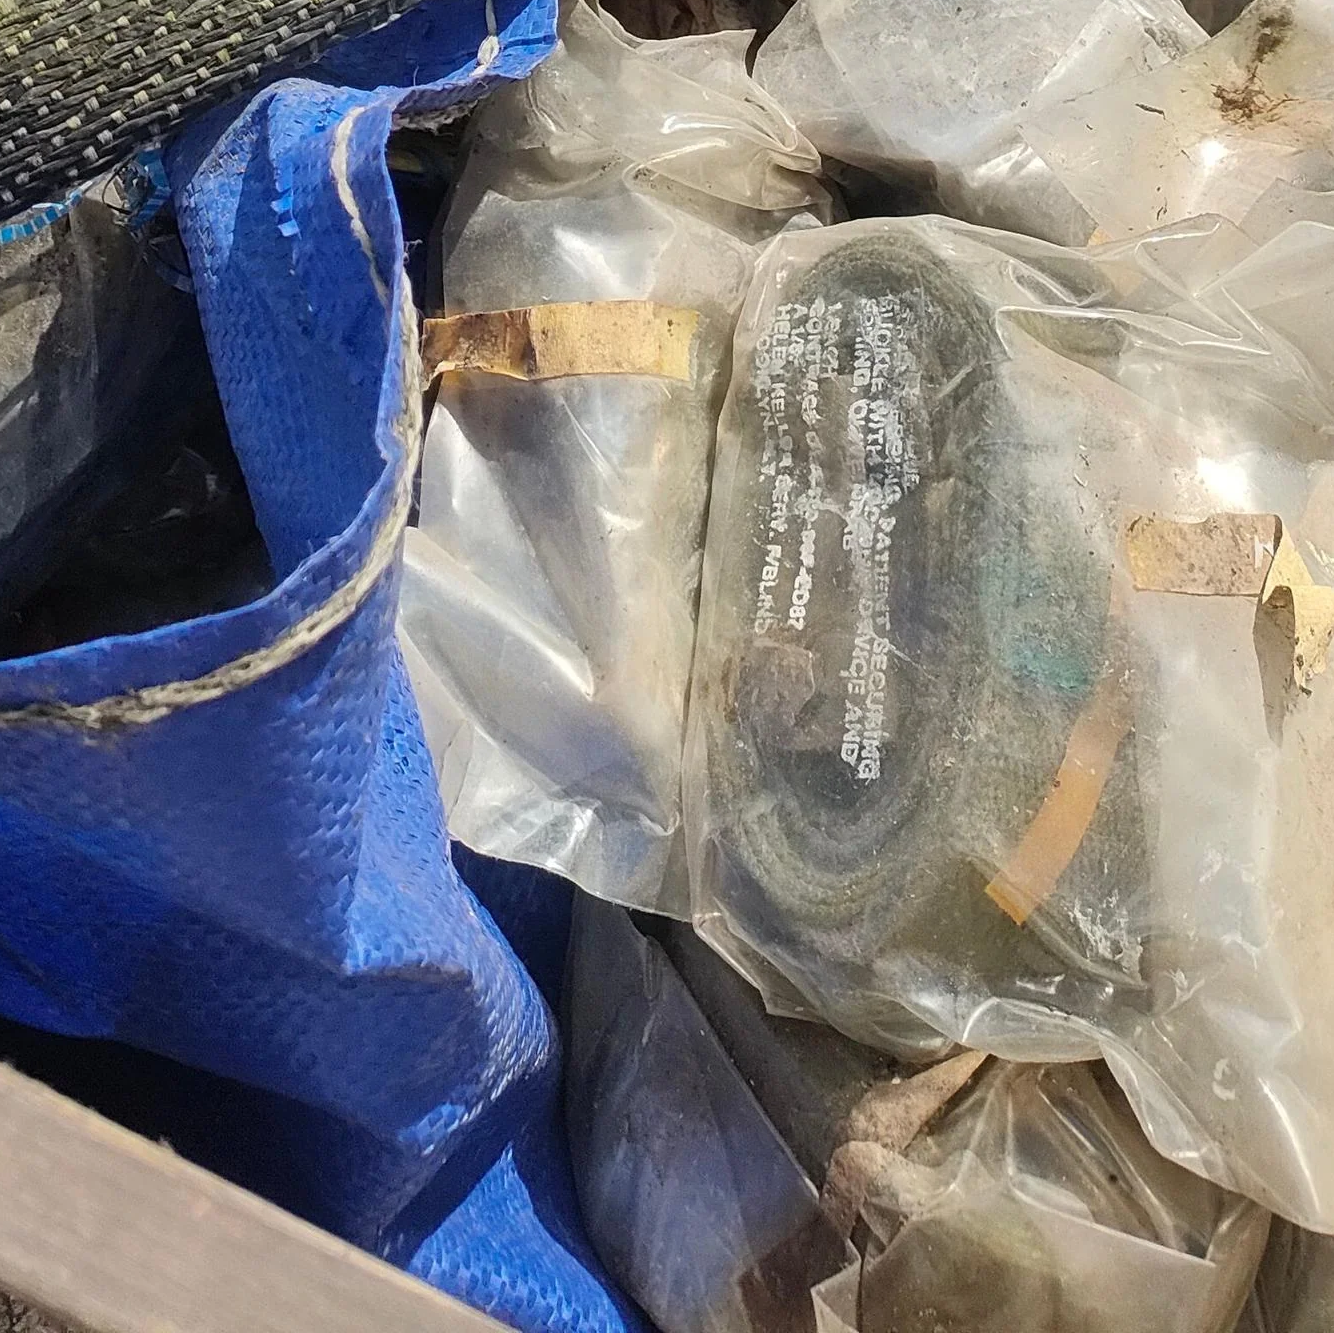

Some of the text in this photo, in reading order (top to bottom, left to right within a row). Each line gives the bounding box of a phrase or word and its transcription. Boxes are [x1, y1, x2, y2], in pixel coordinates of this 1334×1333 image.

[771, 303, 793, 375] HELEN
[871, 294, 899, 393] BUCKLE
[875, 516, 897, 631] PATIENT
[841, 699, 863, 767] AND
[856, 638, 889, 785] SECURING
